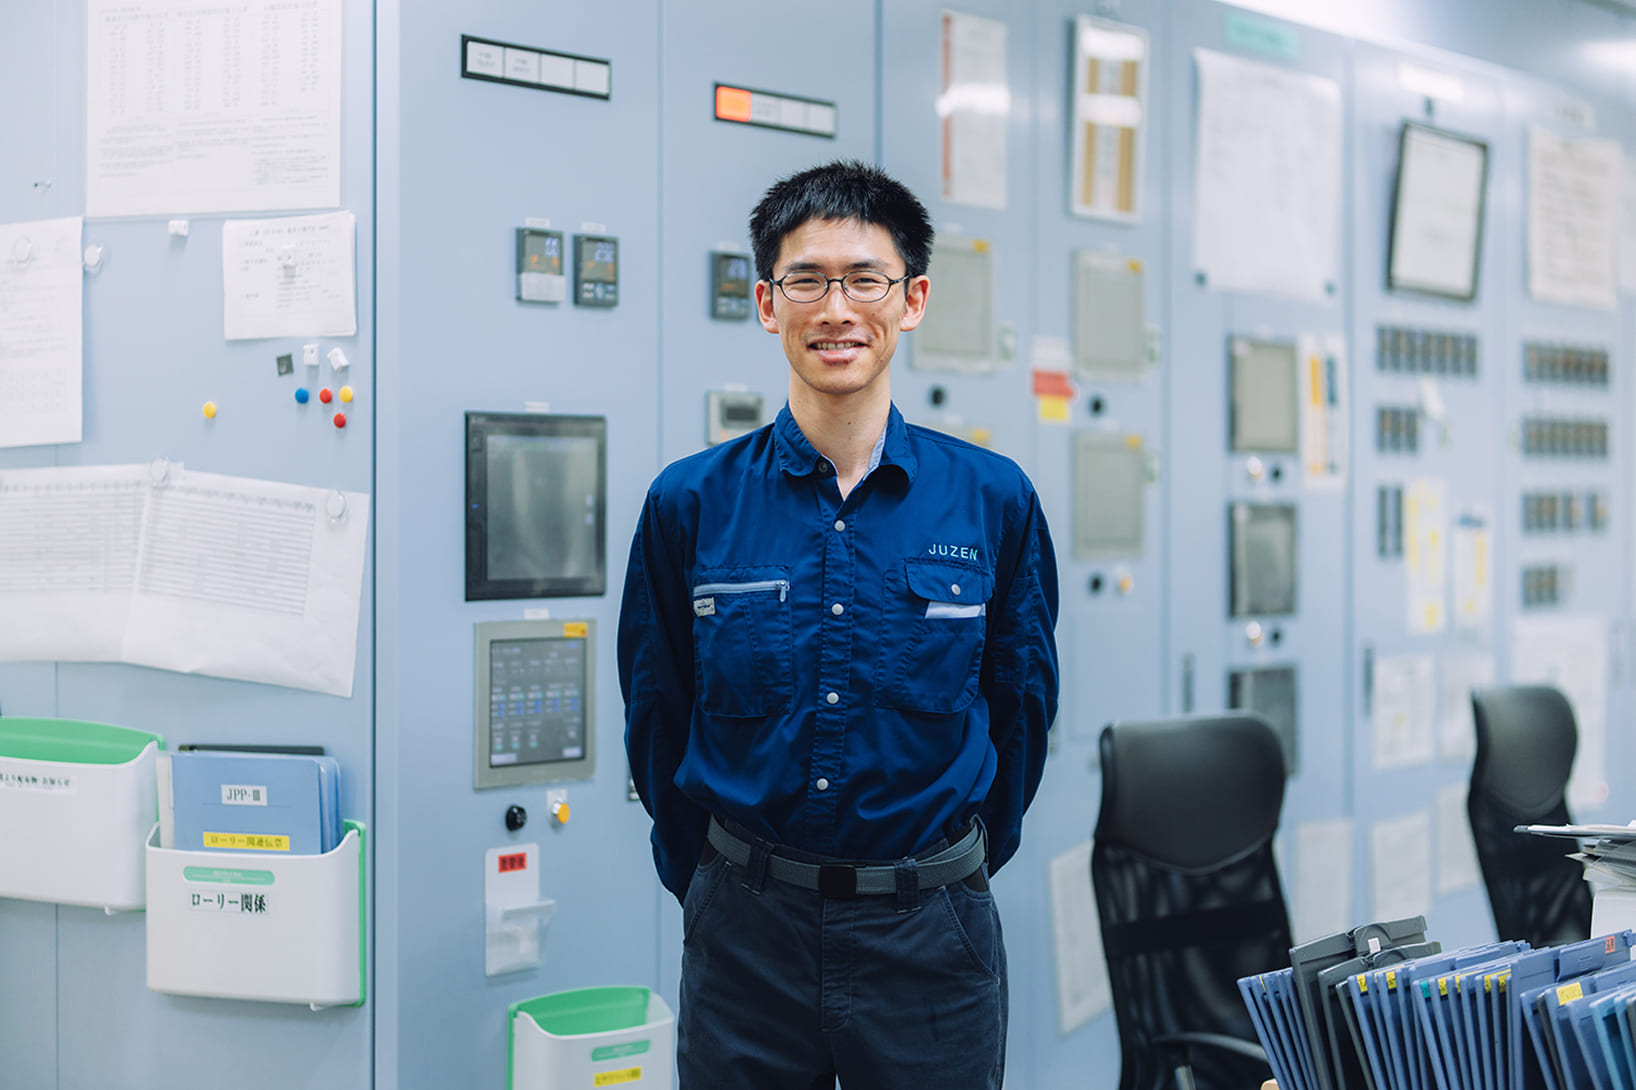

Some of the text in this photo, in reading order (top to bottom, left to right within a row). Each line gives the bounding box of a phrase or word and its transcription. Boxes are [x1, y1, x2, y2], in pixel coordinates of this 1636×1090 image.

[928, 543, 978, 561] JUZEN
[191, 893, 266, 913] ローリー関係
